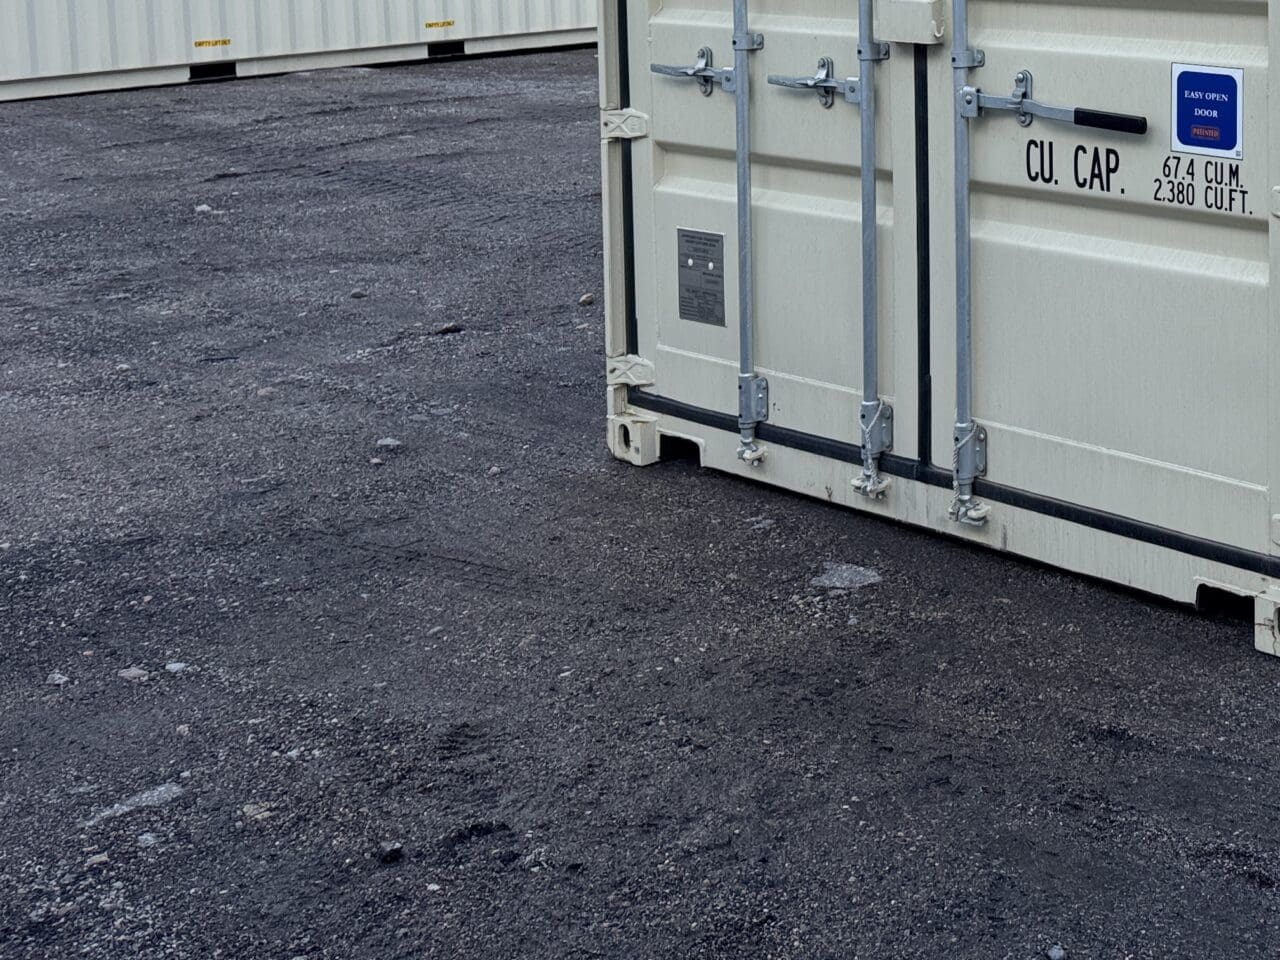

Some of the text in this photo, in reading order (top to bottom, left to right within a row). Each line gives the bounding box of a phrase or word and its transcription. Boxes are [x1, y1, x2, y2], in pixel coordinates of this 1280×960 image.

[1184, 90, 1228, 101] EASY OPEN
[1194, 108, 1218, 118] DOOR
[1026, 139, 1244, 194] CU. CAP. 67.4 CU.M.
[1153, 179, 1253, 214] 2,380 CU.FT.
